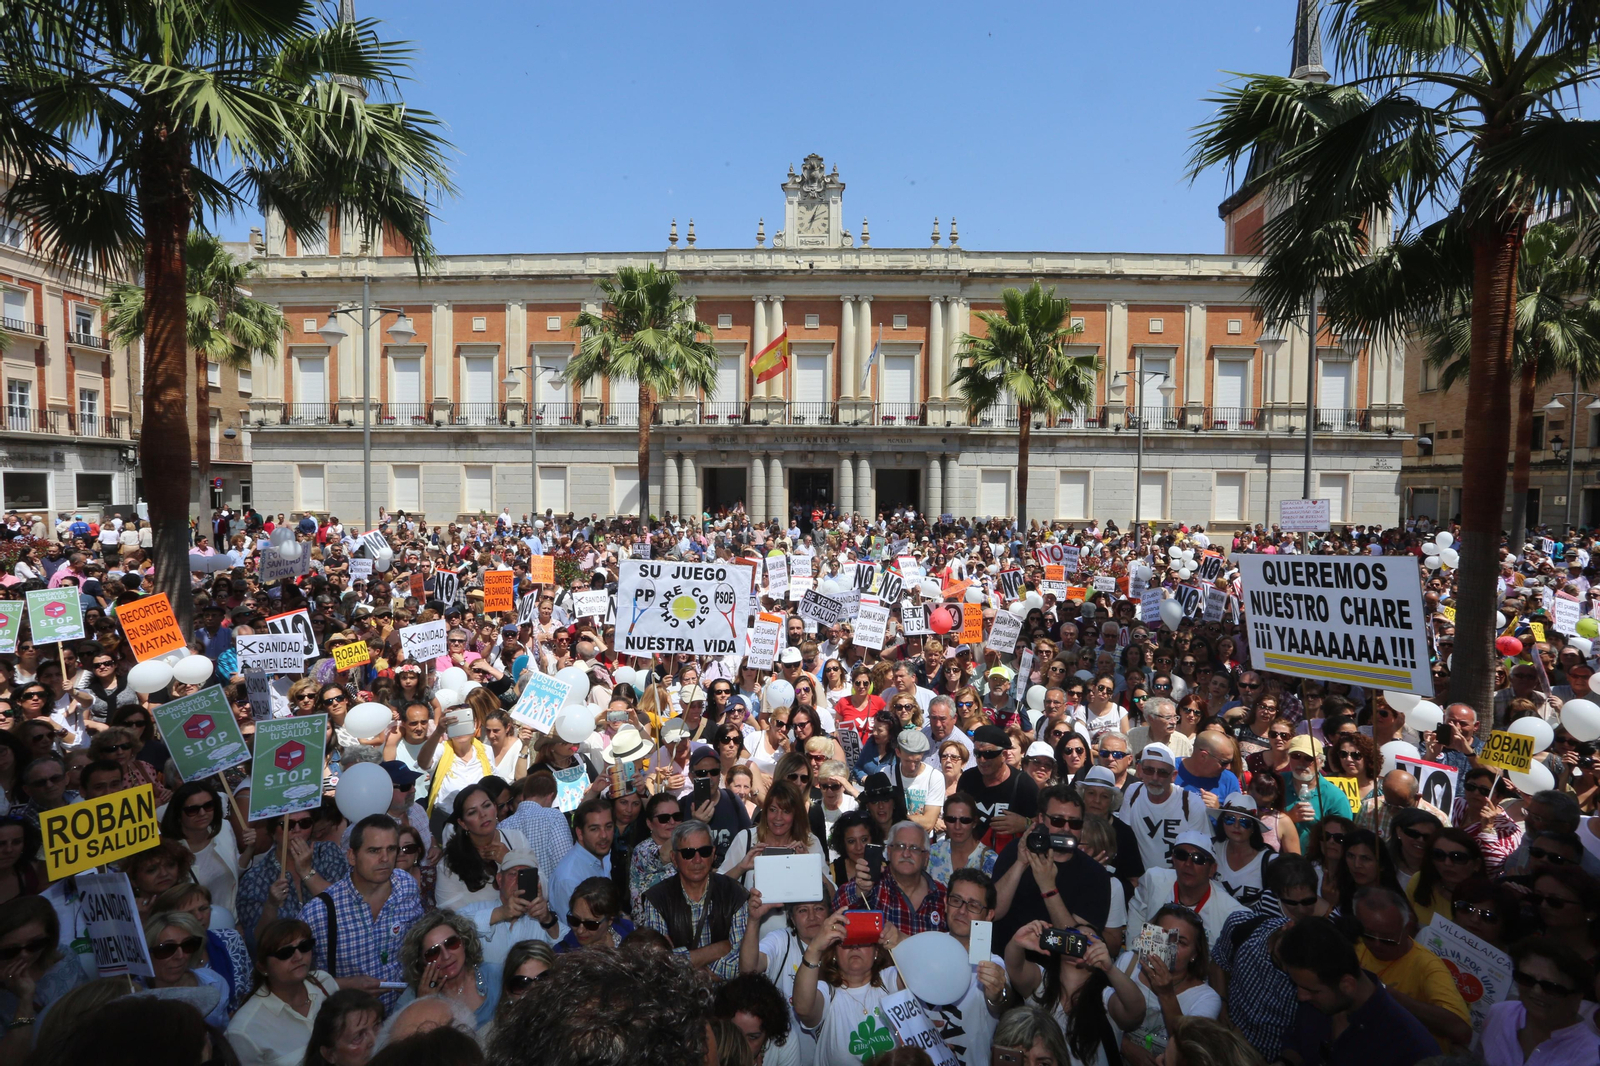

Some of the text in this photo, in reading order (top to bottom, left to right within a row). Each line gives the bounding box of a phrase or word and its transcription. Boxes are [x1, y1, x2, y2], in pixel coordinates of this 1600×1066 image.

[1038, 545, 1063, 565] NO
[1544, 540, 1553, 553] NO
[268, 552, 281, 560] PO
[270, 567, 295, 578] DIGNA
[639, 564, 727, 581] SU JUEGO
[854, 564, 874, 590] NO
[1201, 557, 1221, 580] NO
[1262, 560, 1388, 591] QUEREMOS
[435, 572, 455, 603] NO
[485, 575, 512, 584] RECORTES
[877, 572, 902, 602] NO
[1001, 571, 1023, 599] NO
[29, 587, 66, 599] Subastando
[485, 587, 512, 596] EN SANIDAD
[635, 588, 655, 602] PP
[715, 591, 733, 604] PSOE
[485, 598, 512, 607] MATAN.
[659, 585, 709, 629] CHARE COSTA
[806, 591, 816, 601] SE
[817, 595, 841, 613] VENDE
[1175, 586, 1199, 616] NO
[1250, 590, 1330, 622] NUESTRO
[1340, 596, 1413, 630] CHARE
[1564, 604, 1579, 612] pueblo
[120, 600, 169, 625] RECORTES
[801, 601, 813, 613] TU
[811, 606, 836, 623] SALUD
[904, 609, 913, 618] SE
[1557, 616, 1576, 625] Susan
[40, 616, 74, 628] STOP
[127, 615, 174, 640] EN SANIDAD
[905, 621, 914, 631] TU
[761, 627, 777, 636] pueblo
[134, 631, 181, 656] MATAN.
[414, 646, 429, 659] CRIMEN
[625, 637, 737, 653] NUESTRA VIDA
[751, 647, 773, 656] Susana
[335, 644, 367, 662] ROBAN
[337, 654, 368, 669] TU SALUD!
[749, 657, 758, 665] NO
[251, 657, 302, 669] CRIMEN LEGAL!
[532, 673, 570, 692] JUSTICIA
[540, 684, 566, 698] SANIDAD
[156, 695, 206, 717] Subastando
[171, 700, 211, 720] tu SALUD
[259, 720, 309, 733] Subastando
[270, 727, 312, 740] tu SALUD
[183, 731, 228, 756] STOP
[841, 731, 849, 743] TU
[850, 732, 857, 744] SE
[1485, 734, 1533, 757] ROBAN
[1481, 749, 1529, 768] TU SALUD!
[264, 768, 312, 786] STOP
[47, 791, 153, 849] ROBAN
[50, 822, 155, 868] TU SALUD!
[1439, 921, 1512, 970] VILLABLANCA
[1464, 956, 1482, 975] POR
[888, 998, 921, 1028] sana!
[853, 1034, 891, 1052] FIBRONUBA
